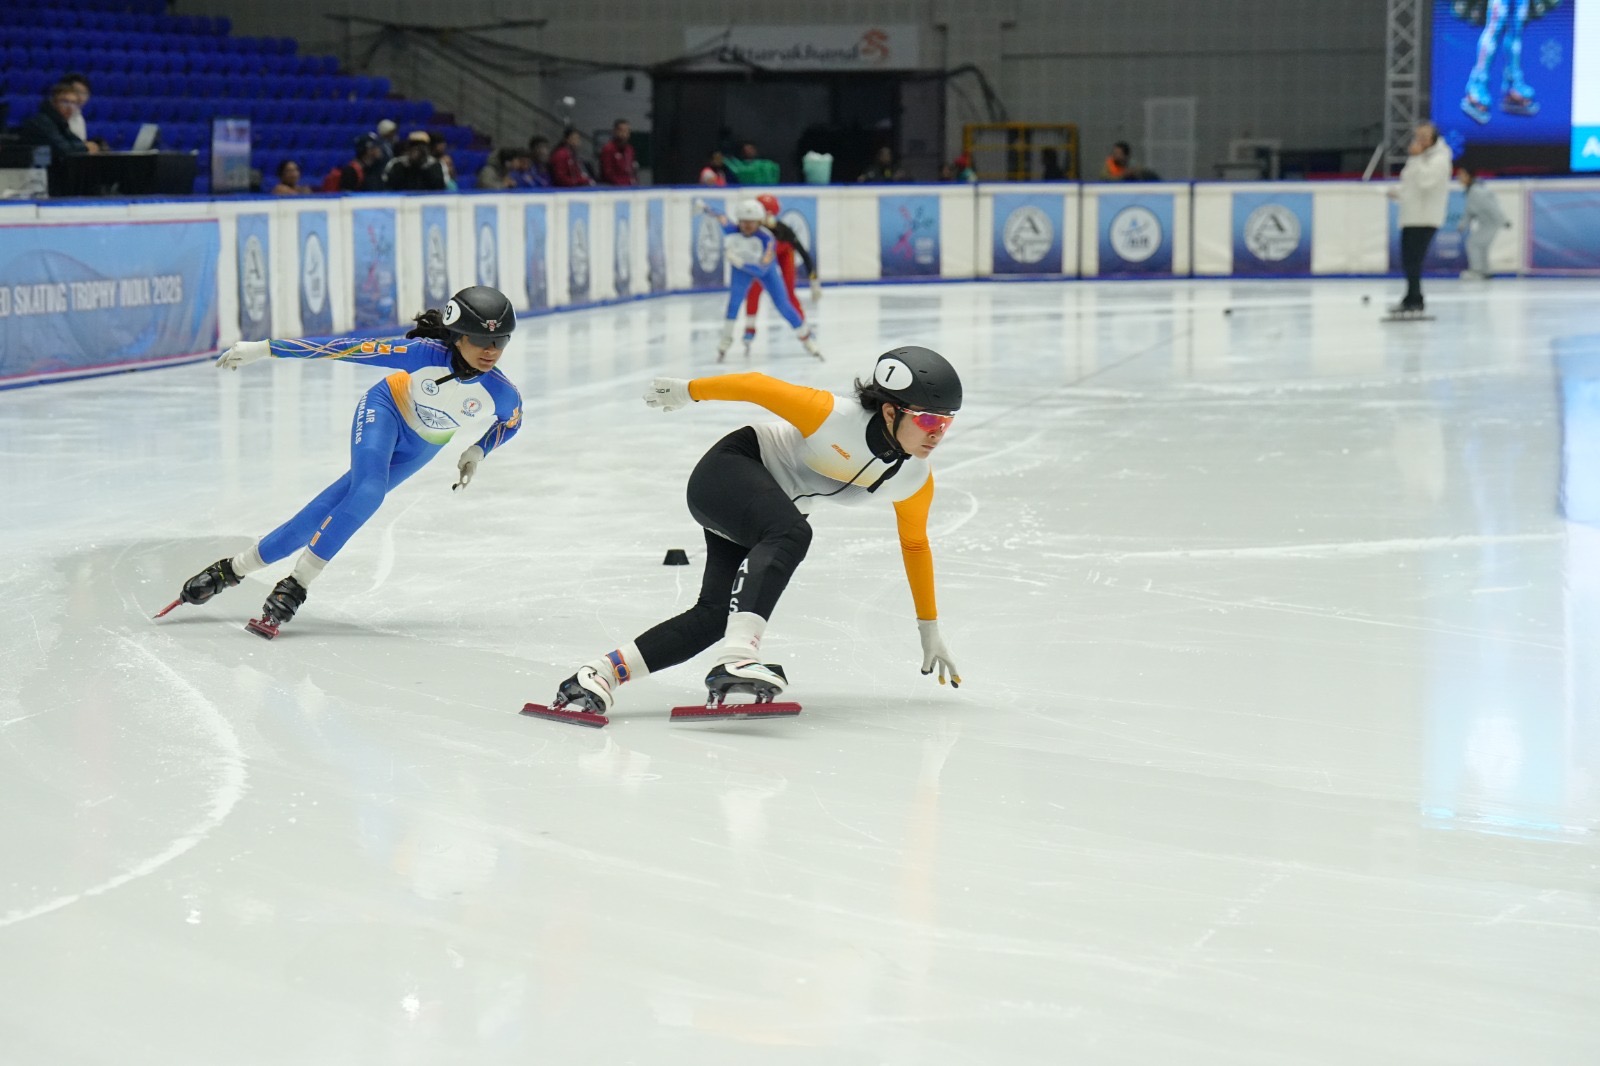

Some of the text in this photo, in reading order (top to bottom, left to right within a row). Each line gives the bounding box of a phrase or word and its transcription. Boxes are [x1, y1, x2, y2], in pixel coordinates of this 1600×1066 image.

[14, 283, 68, 315] SKATING
[70, 279, 117, 311] TROPHY
[120, 277, 151, 307] INDIA
[365, 408, 376, 424] AIR
[729, 558, 749, 614] AUS
